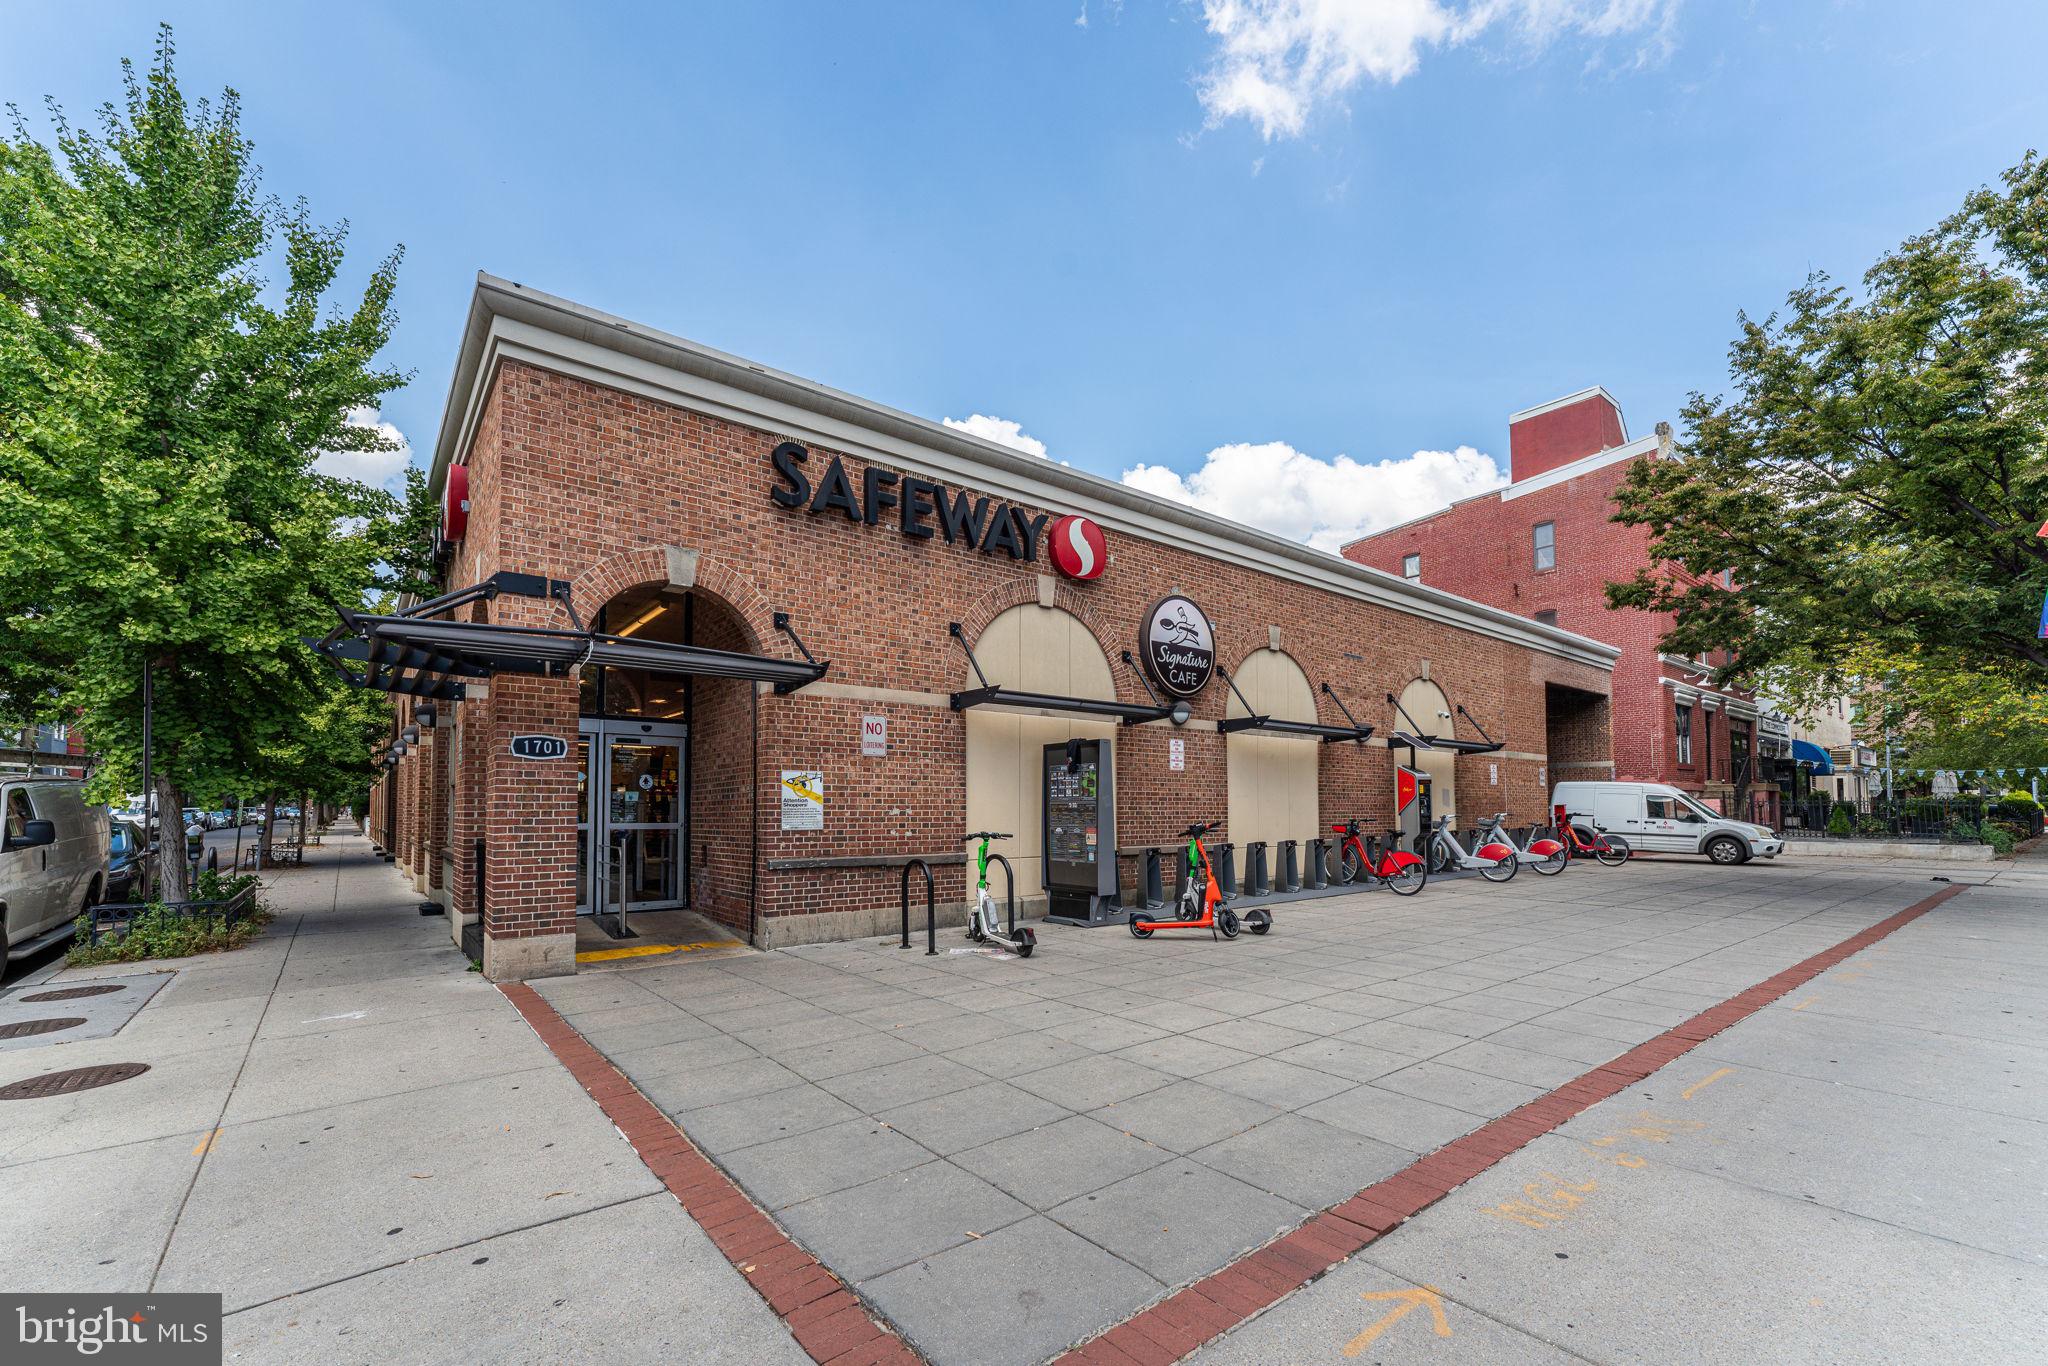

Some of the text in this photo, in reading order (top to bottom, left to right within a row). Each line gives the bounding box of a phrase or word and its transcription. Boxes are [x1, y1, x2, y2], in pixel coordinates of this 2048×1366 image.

[771, 442, 1050, 562] SAFEWAY
[1157, 645, 1209, 669] Signature
[1169, 669, 1197, 686] CAFE
[866, 722, 883, 736] NO
[523, 740, 561, 754] 1701
